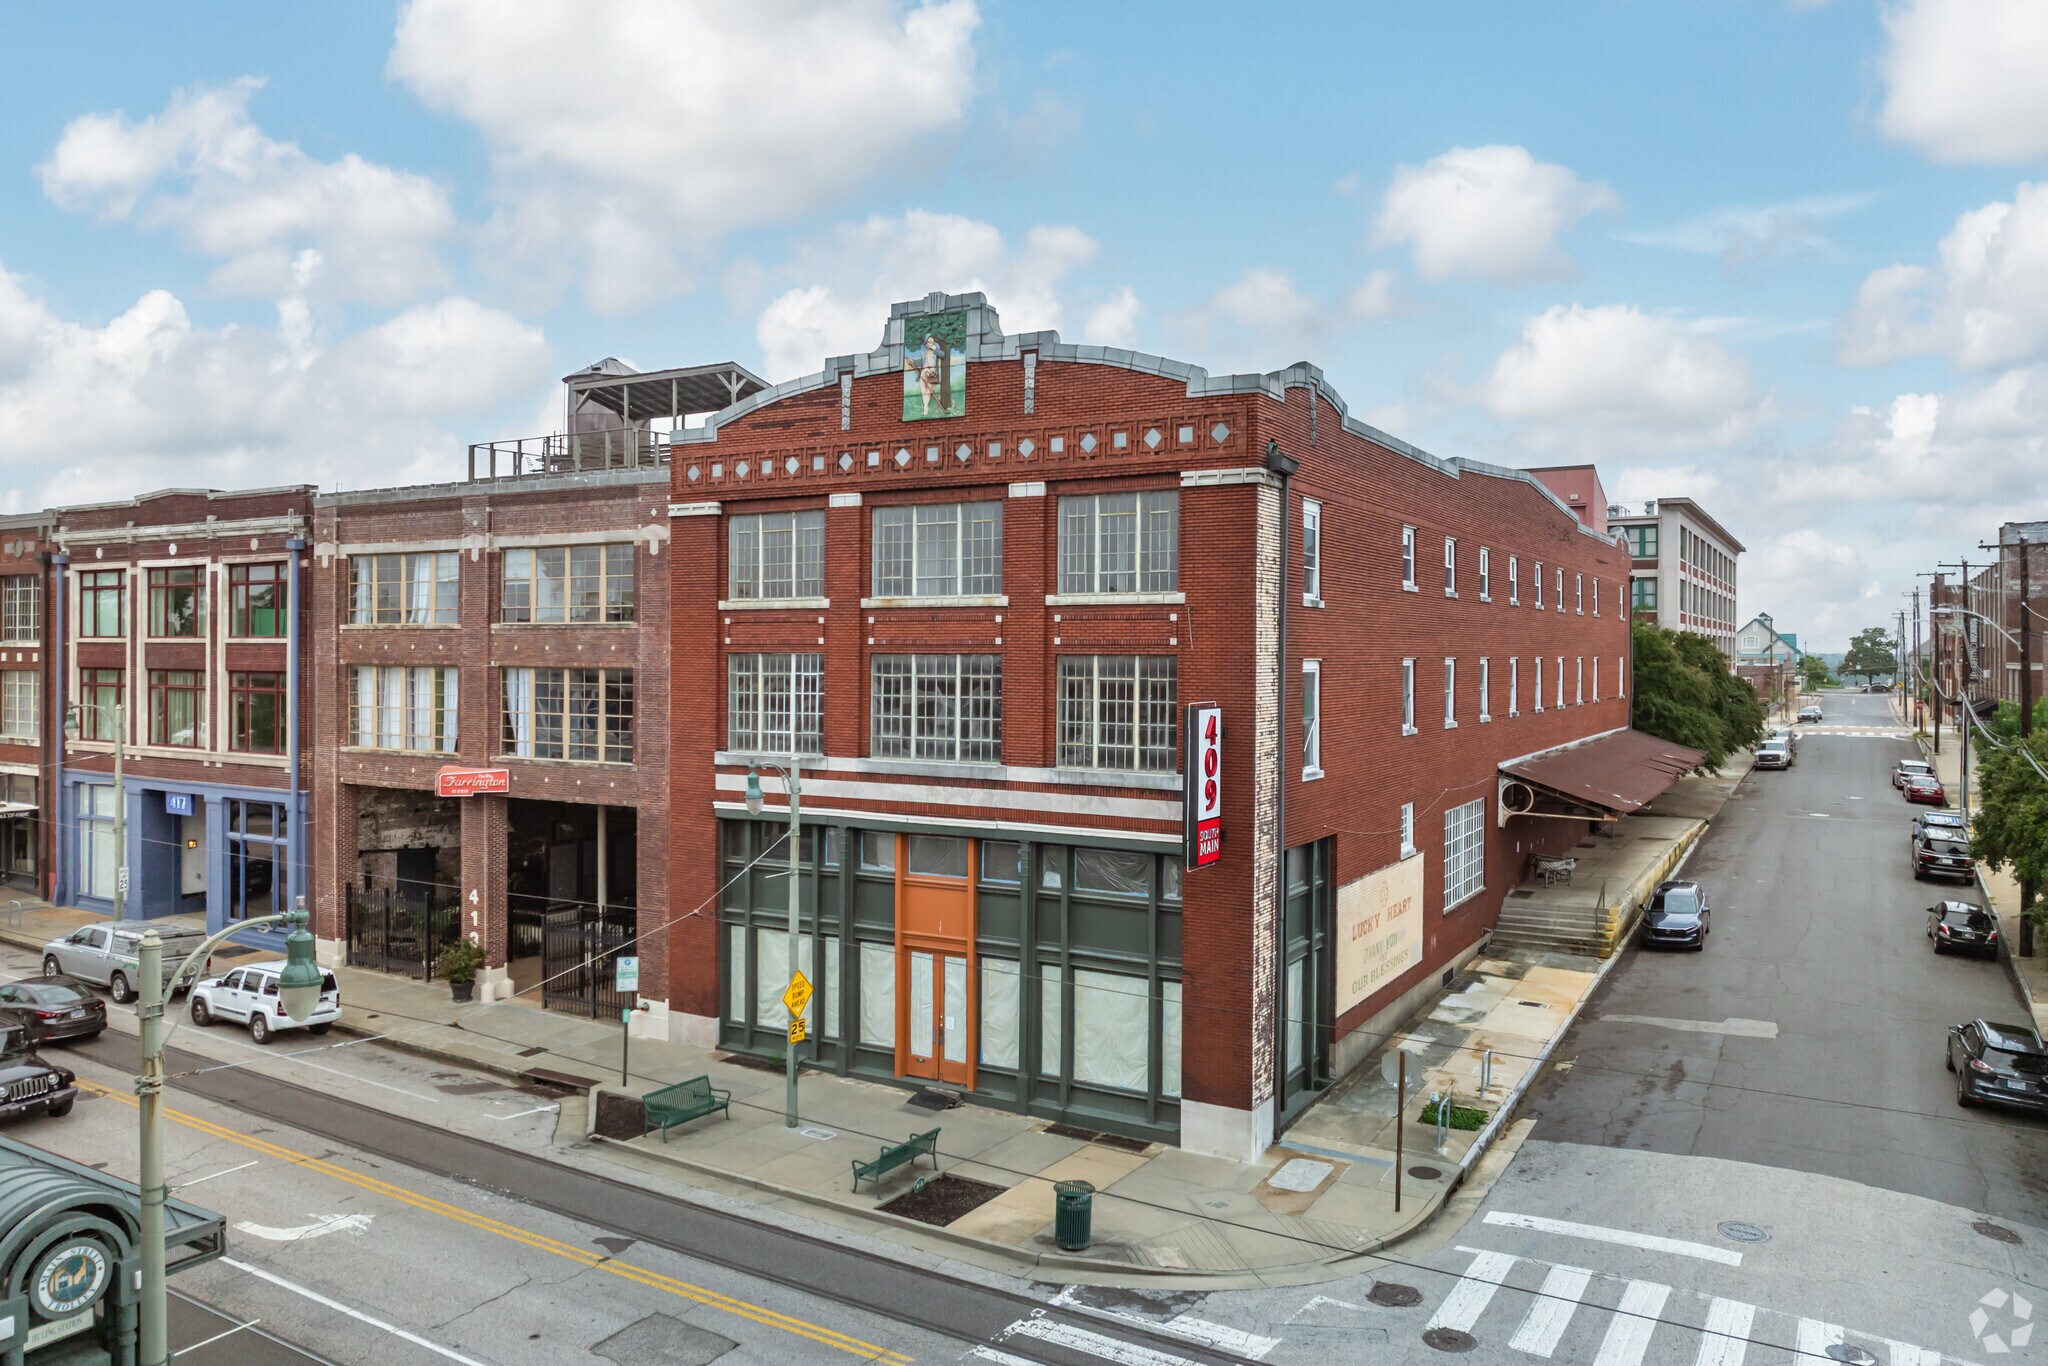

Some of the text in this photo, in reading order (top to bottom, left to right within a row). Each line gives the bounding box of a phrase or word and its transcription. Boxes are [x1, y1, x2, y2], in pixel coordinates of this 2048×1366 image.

[1204, 714, 1218, 812] 409
[442, 775, 506, 789] Farrington
[169, 796, 186, 809] 417
[1199, 827, 1219, 842] SOUTH
[1199, 840, 1219, 857] MAIN
[119, 879, 128, 890] 25
[1351, 896, 1412, 942] LUCKY HEART
[1385, 931, 1398, 950] YOU
[1351, 949, 1409, 994] OUR BLESSINGS
[791, 980, 805, 991] SPEED
[791, 998, 805, 1007] AHEAD
[791, 1021, 805, 1035] 25
[41, 1247, 103, 1284] MAIN STREET
[47, 1288, 96, 1311] TROLLEY
[57, 1318, 83, 1333] STATION
